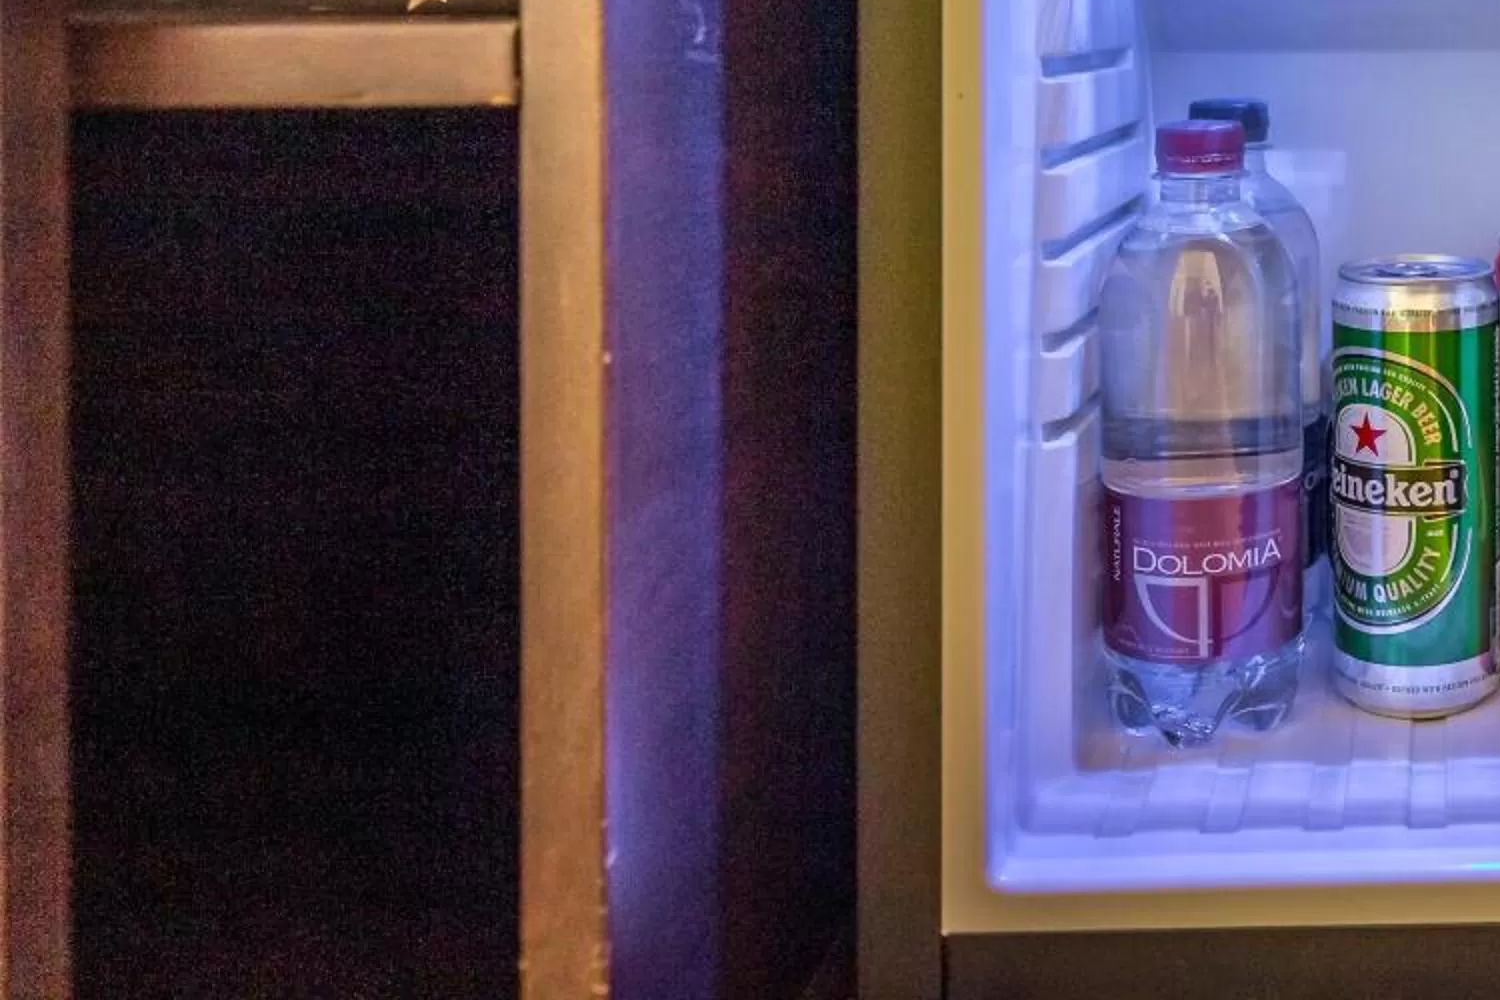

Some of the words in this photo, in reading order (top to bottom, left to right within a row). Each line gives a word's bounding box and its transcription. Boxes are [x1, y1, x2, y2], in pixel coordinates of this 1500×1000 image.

[1361, 378, 1414, 411] LAGER
[1411, 402, 1442, 445] BEER
[1133, 537, 1281, 575] DOLOMIA
[1373, 545, 1441, 604] QUALITY
